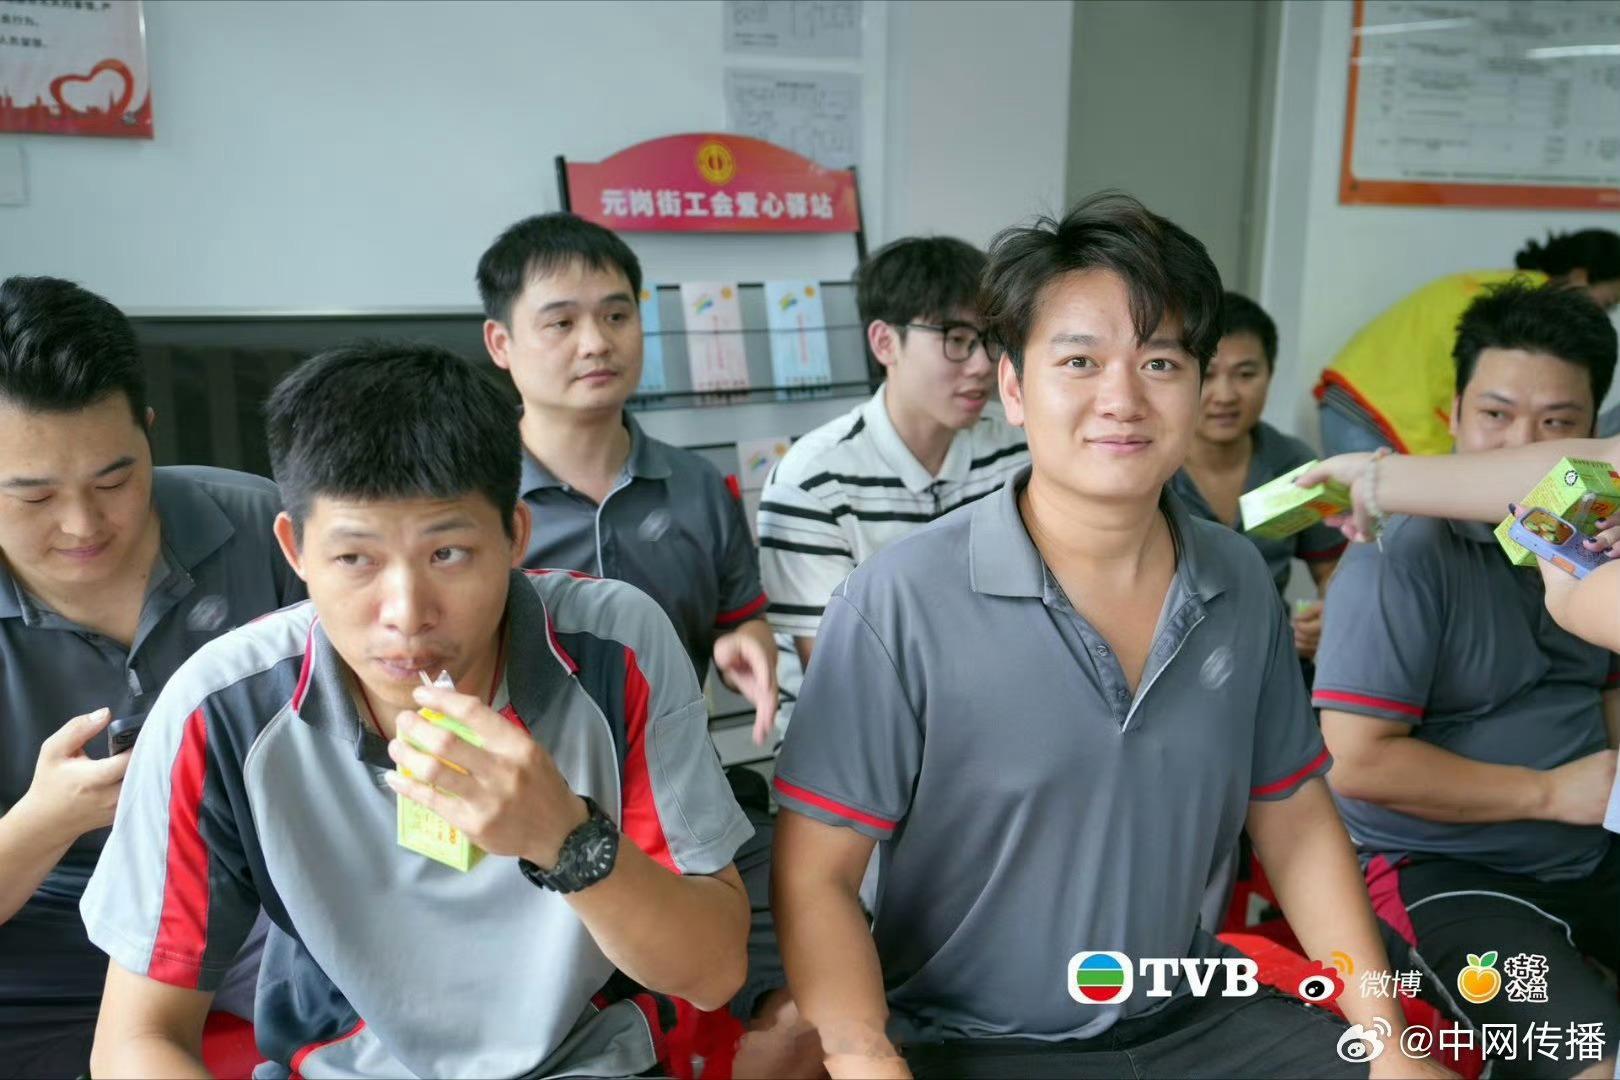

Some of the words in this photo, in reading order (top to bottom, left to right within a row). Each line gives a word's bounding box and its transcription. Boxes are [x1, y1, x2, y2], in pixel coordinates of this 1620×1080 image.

[601, 188, 834, 220] 元岗街工会爱心驿站
